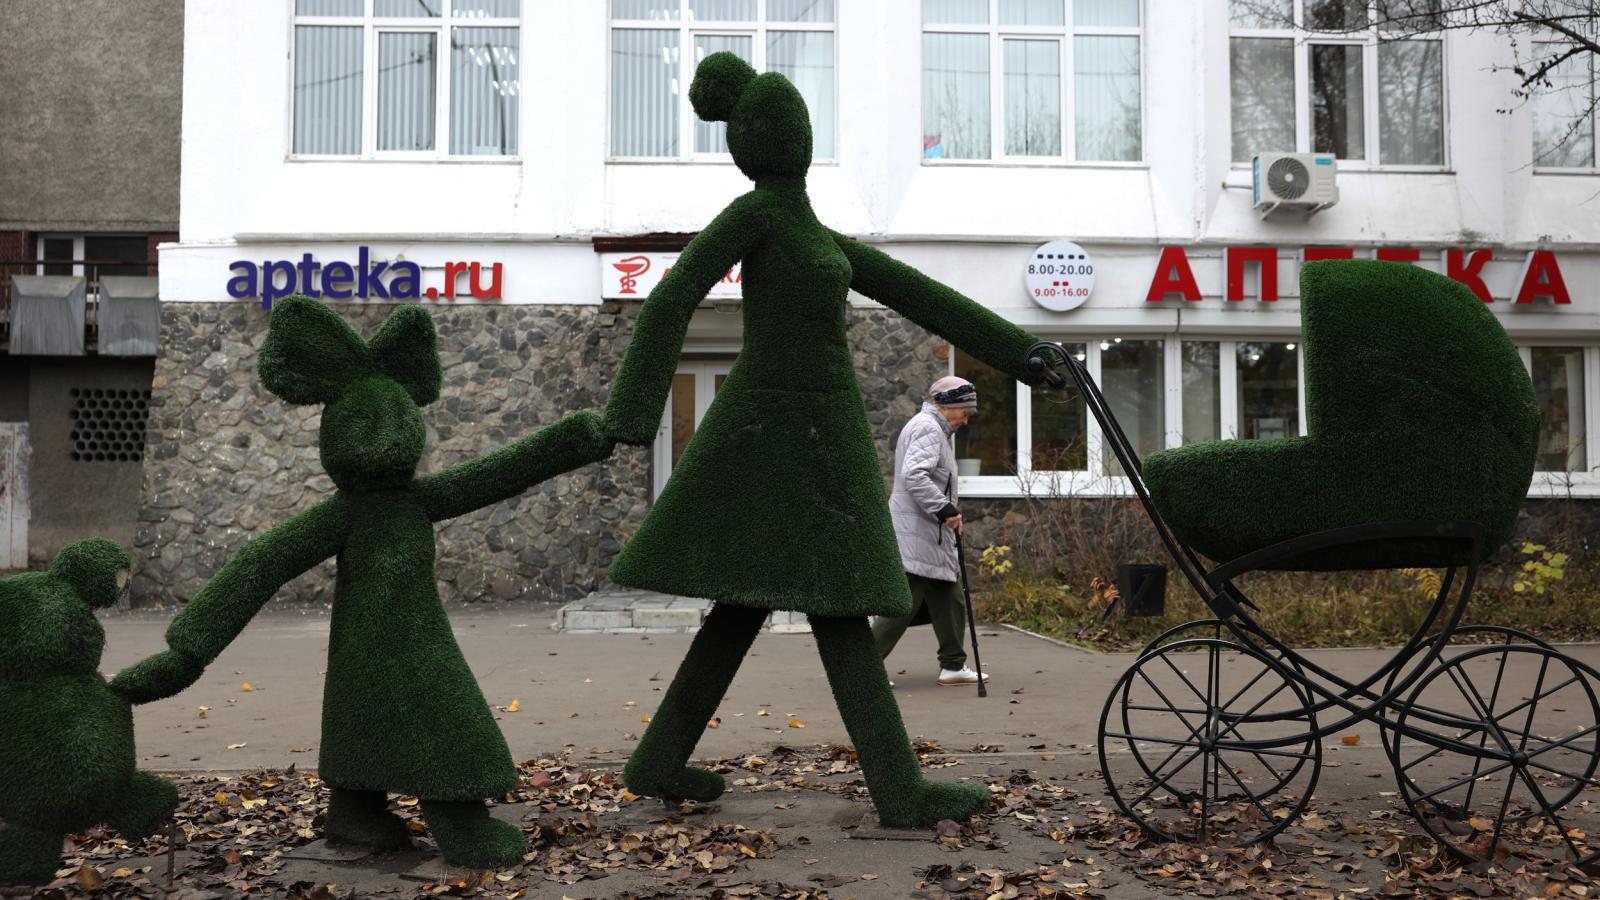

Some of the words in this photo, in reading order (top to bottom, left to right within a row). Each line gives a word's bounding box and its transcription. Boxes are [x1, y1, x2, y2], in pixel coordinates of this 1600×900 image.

[226, 246, 503, 311] apteka.ru
[1027, 264, 1094, 276] 8.00-20.00
[1146, 246, 1572, 305] АПКА
[1034, 287, 1089, 297] 9.00-16.00
